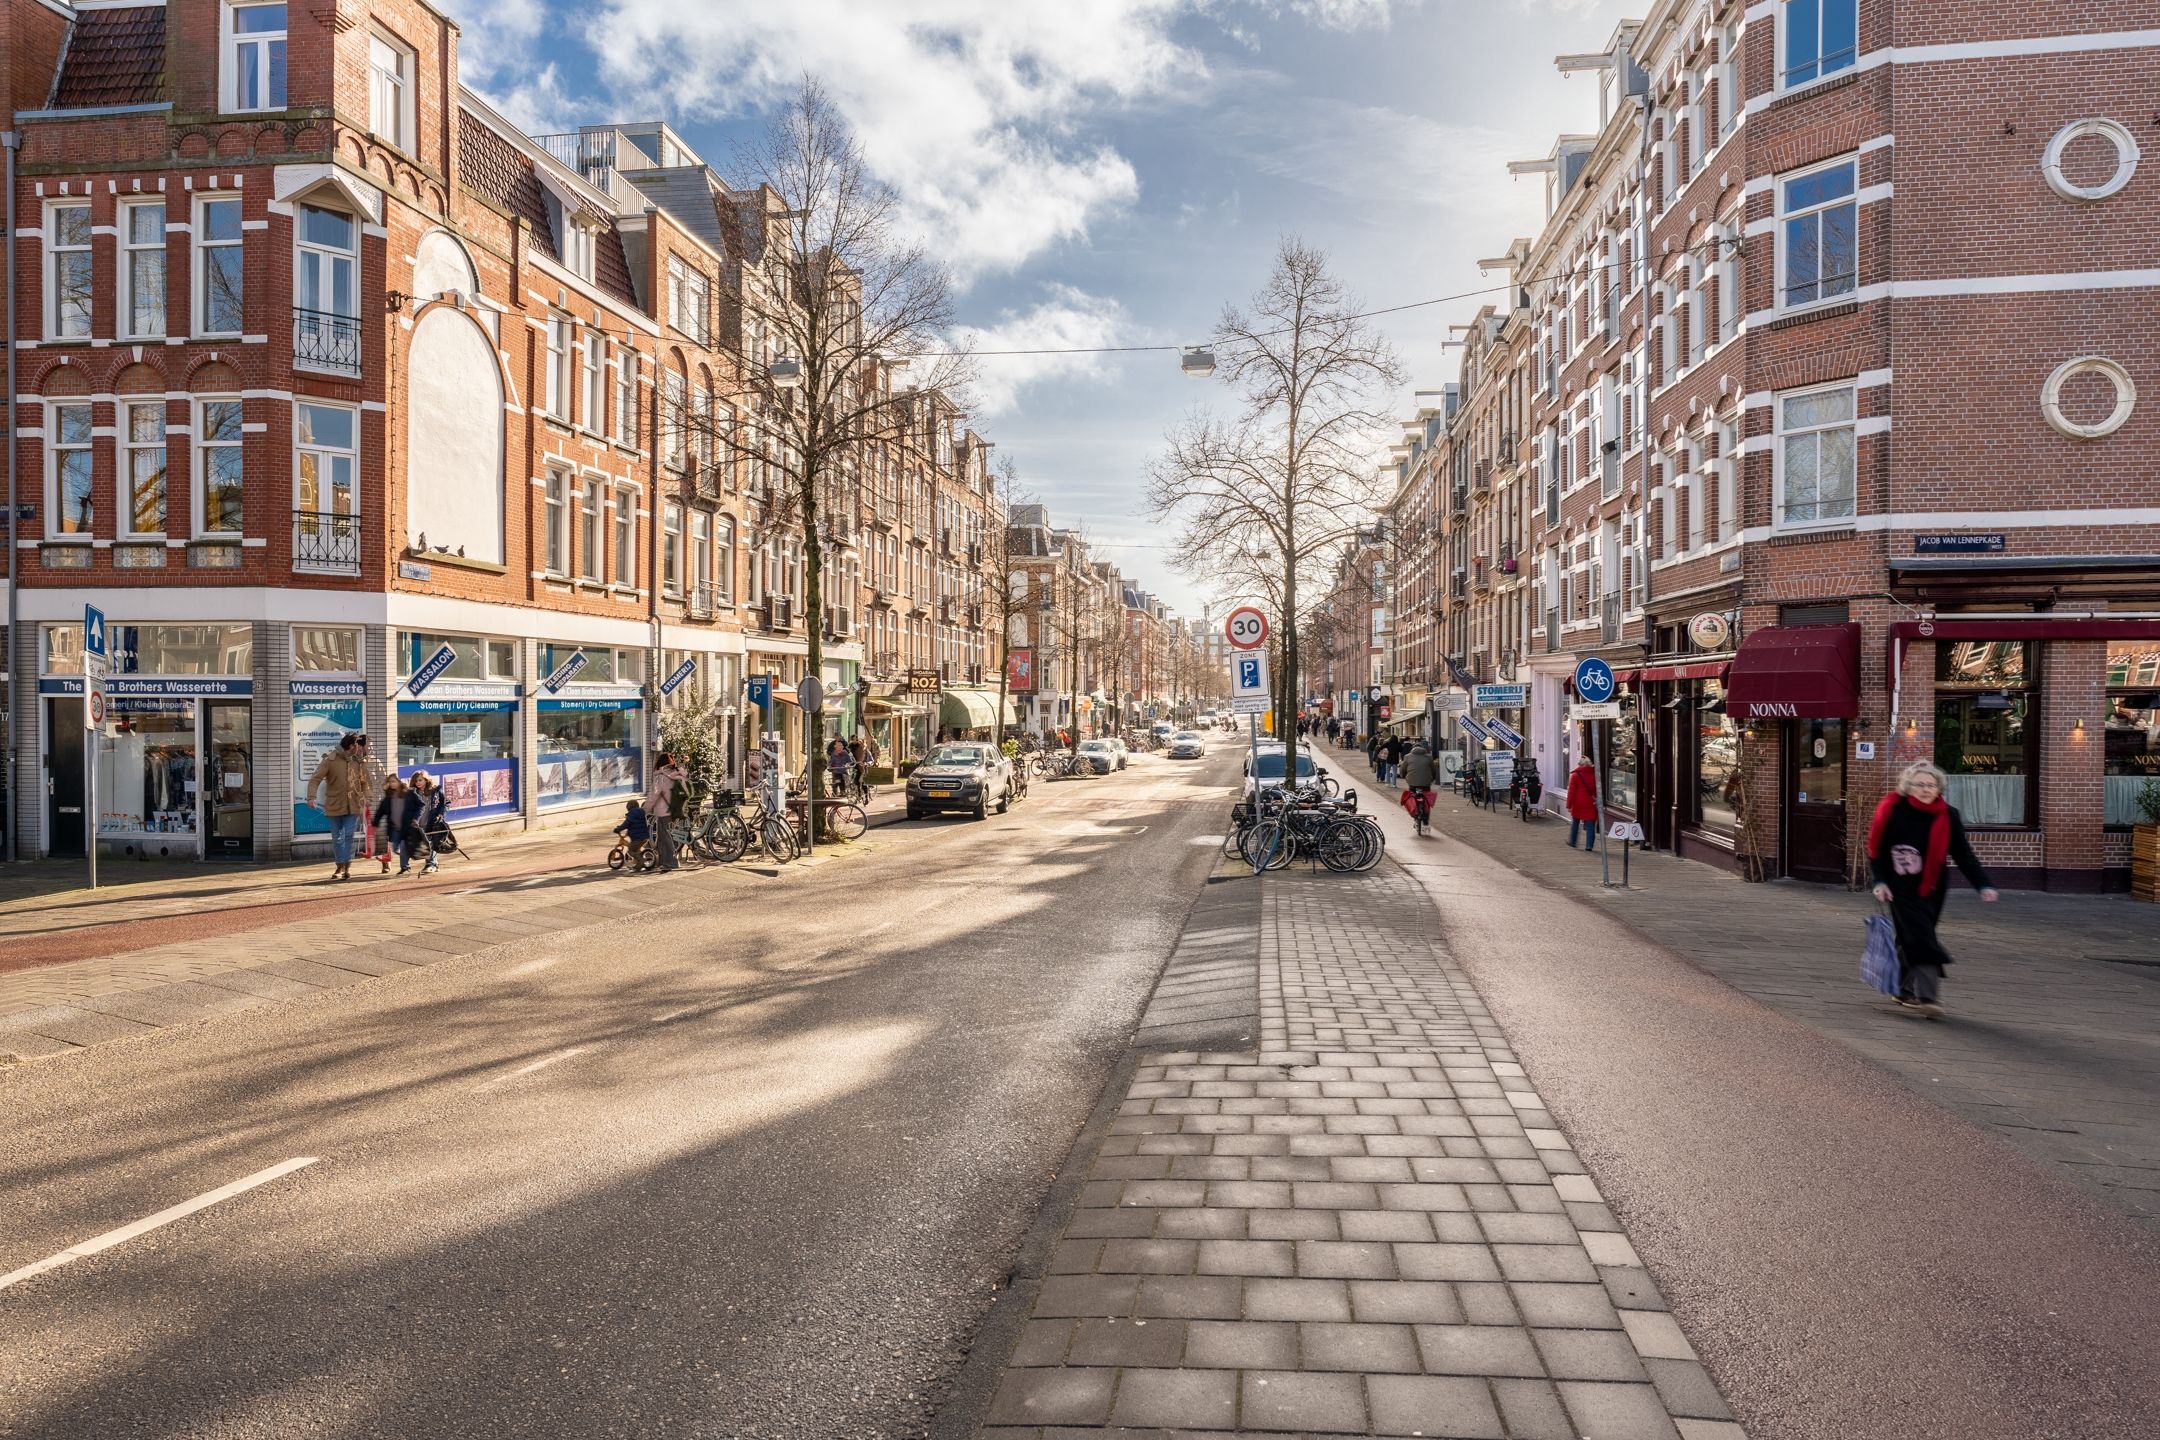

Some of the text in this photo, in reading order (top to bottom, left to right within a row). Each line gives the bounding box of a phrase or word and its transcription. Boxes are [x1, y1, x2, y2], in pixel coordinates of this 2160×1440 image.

[1920, 537, 1940, 545] JACOB
[1234, 619, 1260, 636] 30
[410, 649, 454, 693] WASSALON
[555, 659, 585, 689] REPARATIE
[1244, 662, 1254, 676] P
[546, 662, 573, 688] KLEDING-
[664, 662, 692, 692] STOMERIJ
[63, 681, 82, 691] The
[119, 682, 162, 692] Brothers
[166, 682, 227, 692] Wasserette
[292, 682, 364, 694] Wasserette
[912, 678, 938, 688] ROZ
[446, 685, 472, 694] Brothers
[475, 686, 509, 695] Wasserette
[754, 686, 762, 698] P
[1477, 686, 1522, 695] STOMERIJ
[92, 701, 100, 712] 30
[106, 701, 129, 709] omerij
[420, 701, 451, 711] Stomerij
[456, 701, 468, 710] Dry
[470, 702, 499, 710] Cleaning
[561, 701, 584, 709] Stomerij
[1749, 703, 1798, 716] NONNA
[1459, 717, 1485, 740] STOMERIJ
[1962, 755, 1997, 765] NONNA
